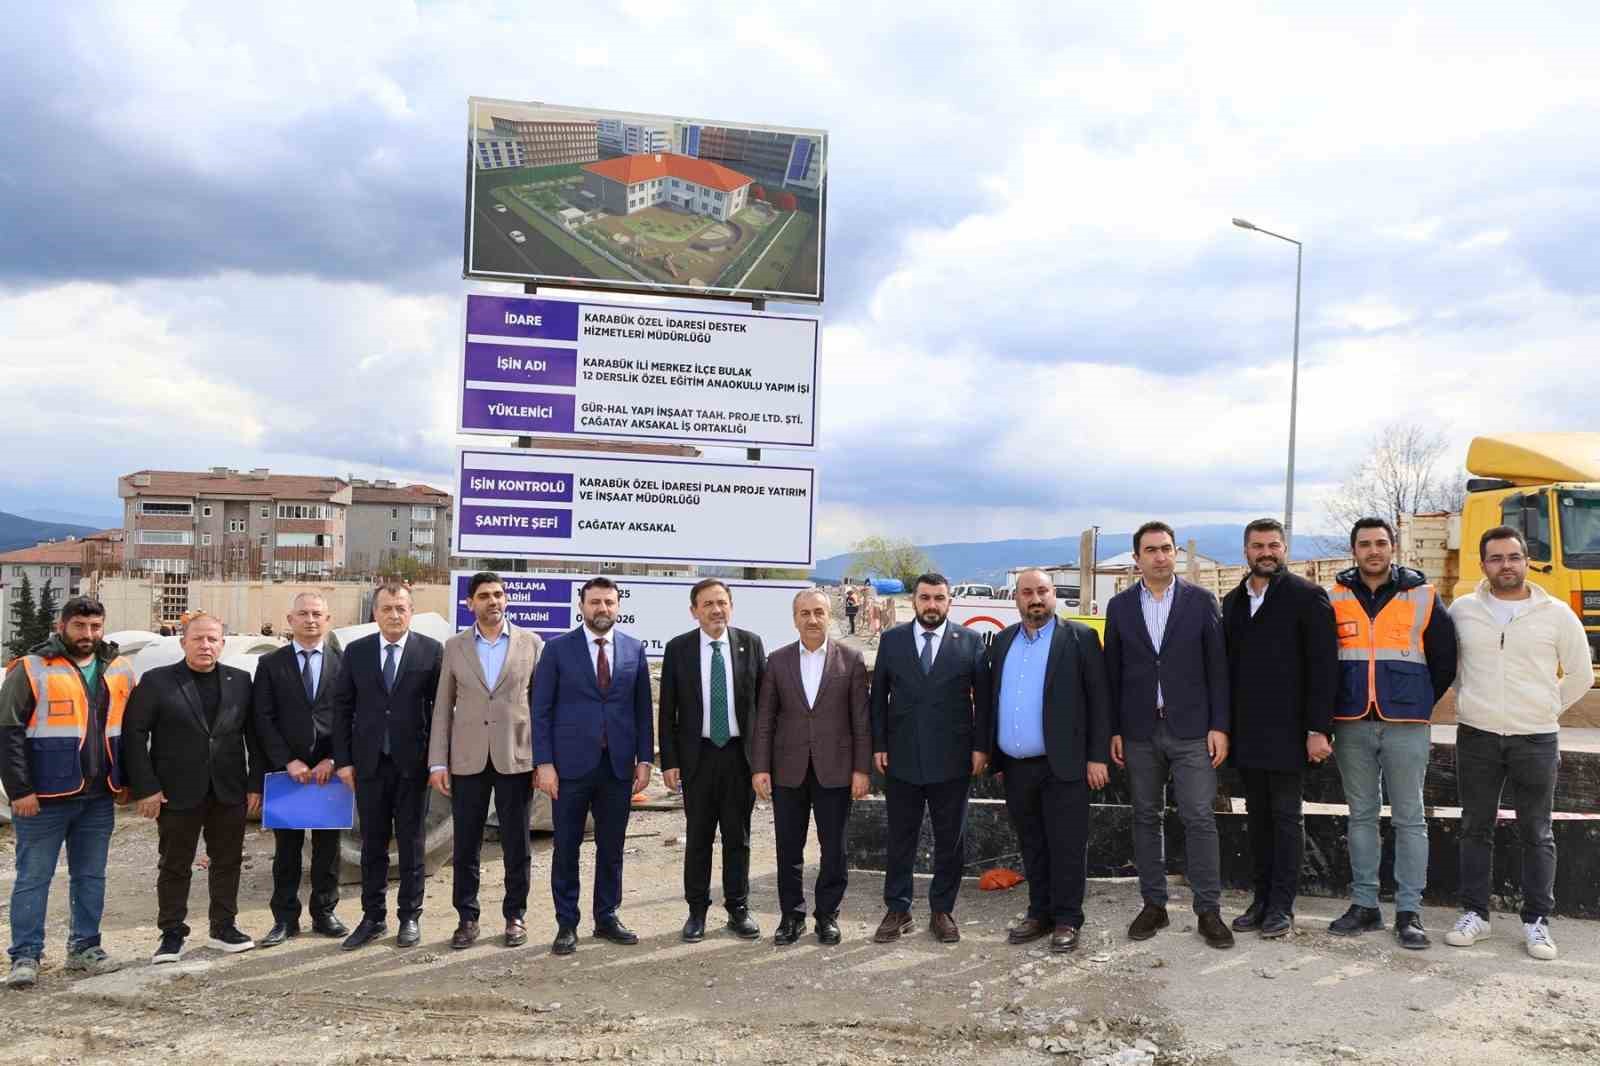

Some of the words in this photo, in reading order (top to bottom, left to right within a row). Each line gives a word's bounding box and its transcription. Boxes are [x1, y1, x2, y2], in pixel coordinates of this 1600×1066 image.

[505, 312, 542, 326] İDARE
[584, 313, 635, 325] KARABÜK
[637, 316, 663, 327] ÖZEL
[666, 317, 706, 330] İDARESİ
[708, 321, 746, 333] DESTEK
[583, 326, 645, 339] HİZMETLERİ
[647, 330, 711, 343] MÜDÜRLÜĞÜ
[497, 356, 521, 371] İŞİN
[524, 360, 546, 371] ADI
[583, 358, 633, 370] KARABÜK
[636, 359, 648, 370] İLİ
[651, 362, 692, 373] MERKEZ
[694, 363, 716, 375] İLÇE
[718, 366, 752, 377] BULAK
[583, 371, 593, 380] 12
[596, 371, 639, 383] DERSLİK
[641, 373, 667, 385] ÖZEL
[670, 375, 704, 387] EĞİTİM
[706, 379, 762, 391] ANAOKULU
[764, 382, 795, 393] YAPIM
[797, 382, 809, 394] İŞİ
[488, 403, 553, 418] YÜKLENİCİ
[581, 402, 628, 414] GÜR-HAL
[631, 406, 654, 416] YAPI
[656, 406, 694, 418] İNŞAAT
[696, 410, 725, 420] TAAH.
[728, 412, 760, 422] PROJE
[763, 413, 783, 424] LTD.
[580, 415, 628, 428] ÇAĞATAY
[631, 419, 679, 431] AKSAKAL
[681, 421, 691, 432] İŞ
[693, 422, 746, 434] ORTAKLIĞI
[470, 476, 495, 491] İŞİN
[498, 480, 565, 493] KONTROLÜ
[579, 477, 630, 489] KARABÜK
[632, 478, 659, 490] ÖZEL
[661, 480, 701, 492] İDARESİ
[704, 483, 731, 493] PLAN
[733, 485, 765, 495] PROJE
[768, 487, 807, 497] YATIRIM
[579, 491, 593, 500] VE
[595, 490, 633, 502] İNŞAAT
[635, 492, 700, 505] MÜDÜRLÜĞÜ
[475, 514, 529, 528] ŞANTİYE
[531, 516, 558, 530] ŞEFİ
[628, 522, 677, 533] AKSAKAL
[507, 591, 531, 601] ARİHİ
[519, 611, 549, 621] TARİHİ
[652, 639, 663, 648] TL
